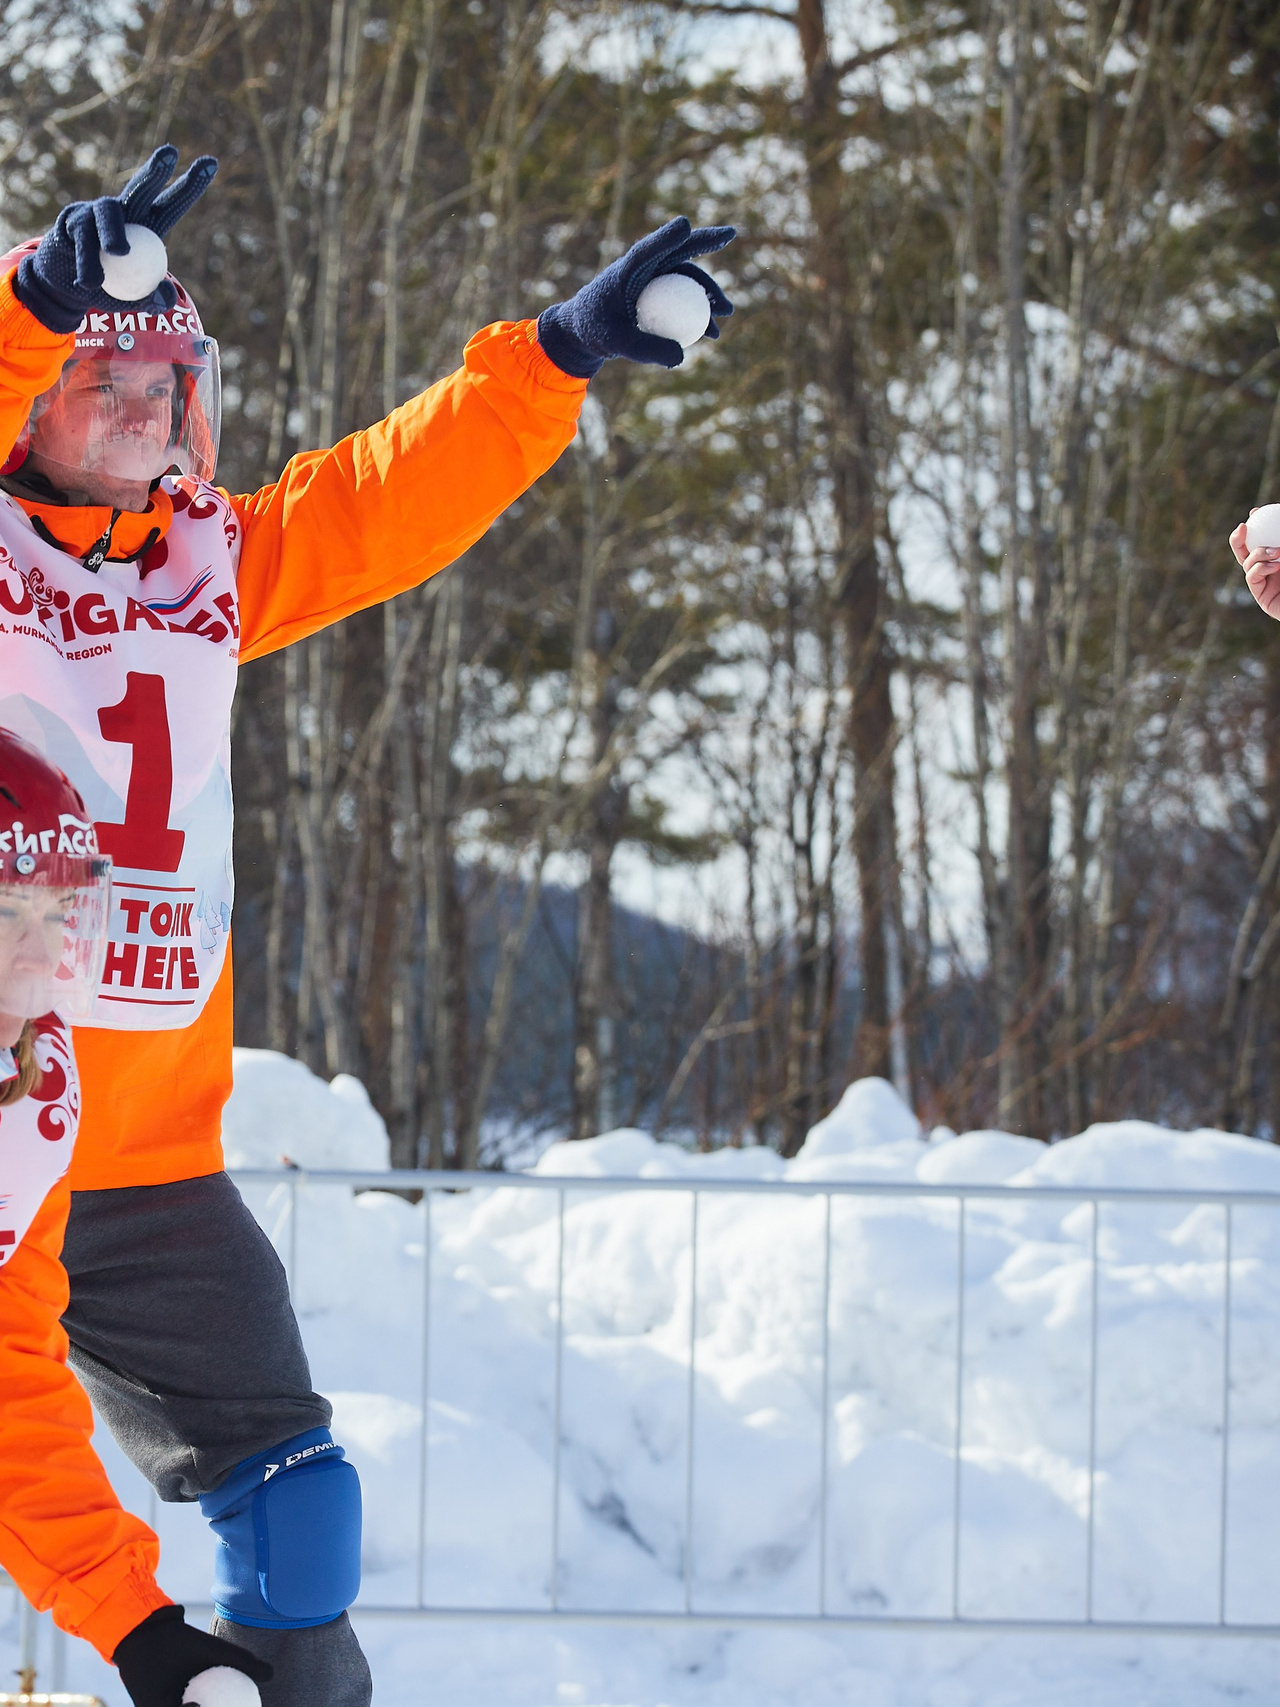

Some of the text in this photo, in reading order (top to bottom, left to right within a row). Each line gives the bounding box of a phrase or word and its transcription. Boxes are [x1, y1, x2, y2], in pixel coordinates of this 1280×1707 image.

[75, 338, 104, 347] АНСК
[66, 643, 113, 661] REGION
[95, 670, 186, 873] 1
[101, 941, 200, 990] НЕГЕ
